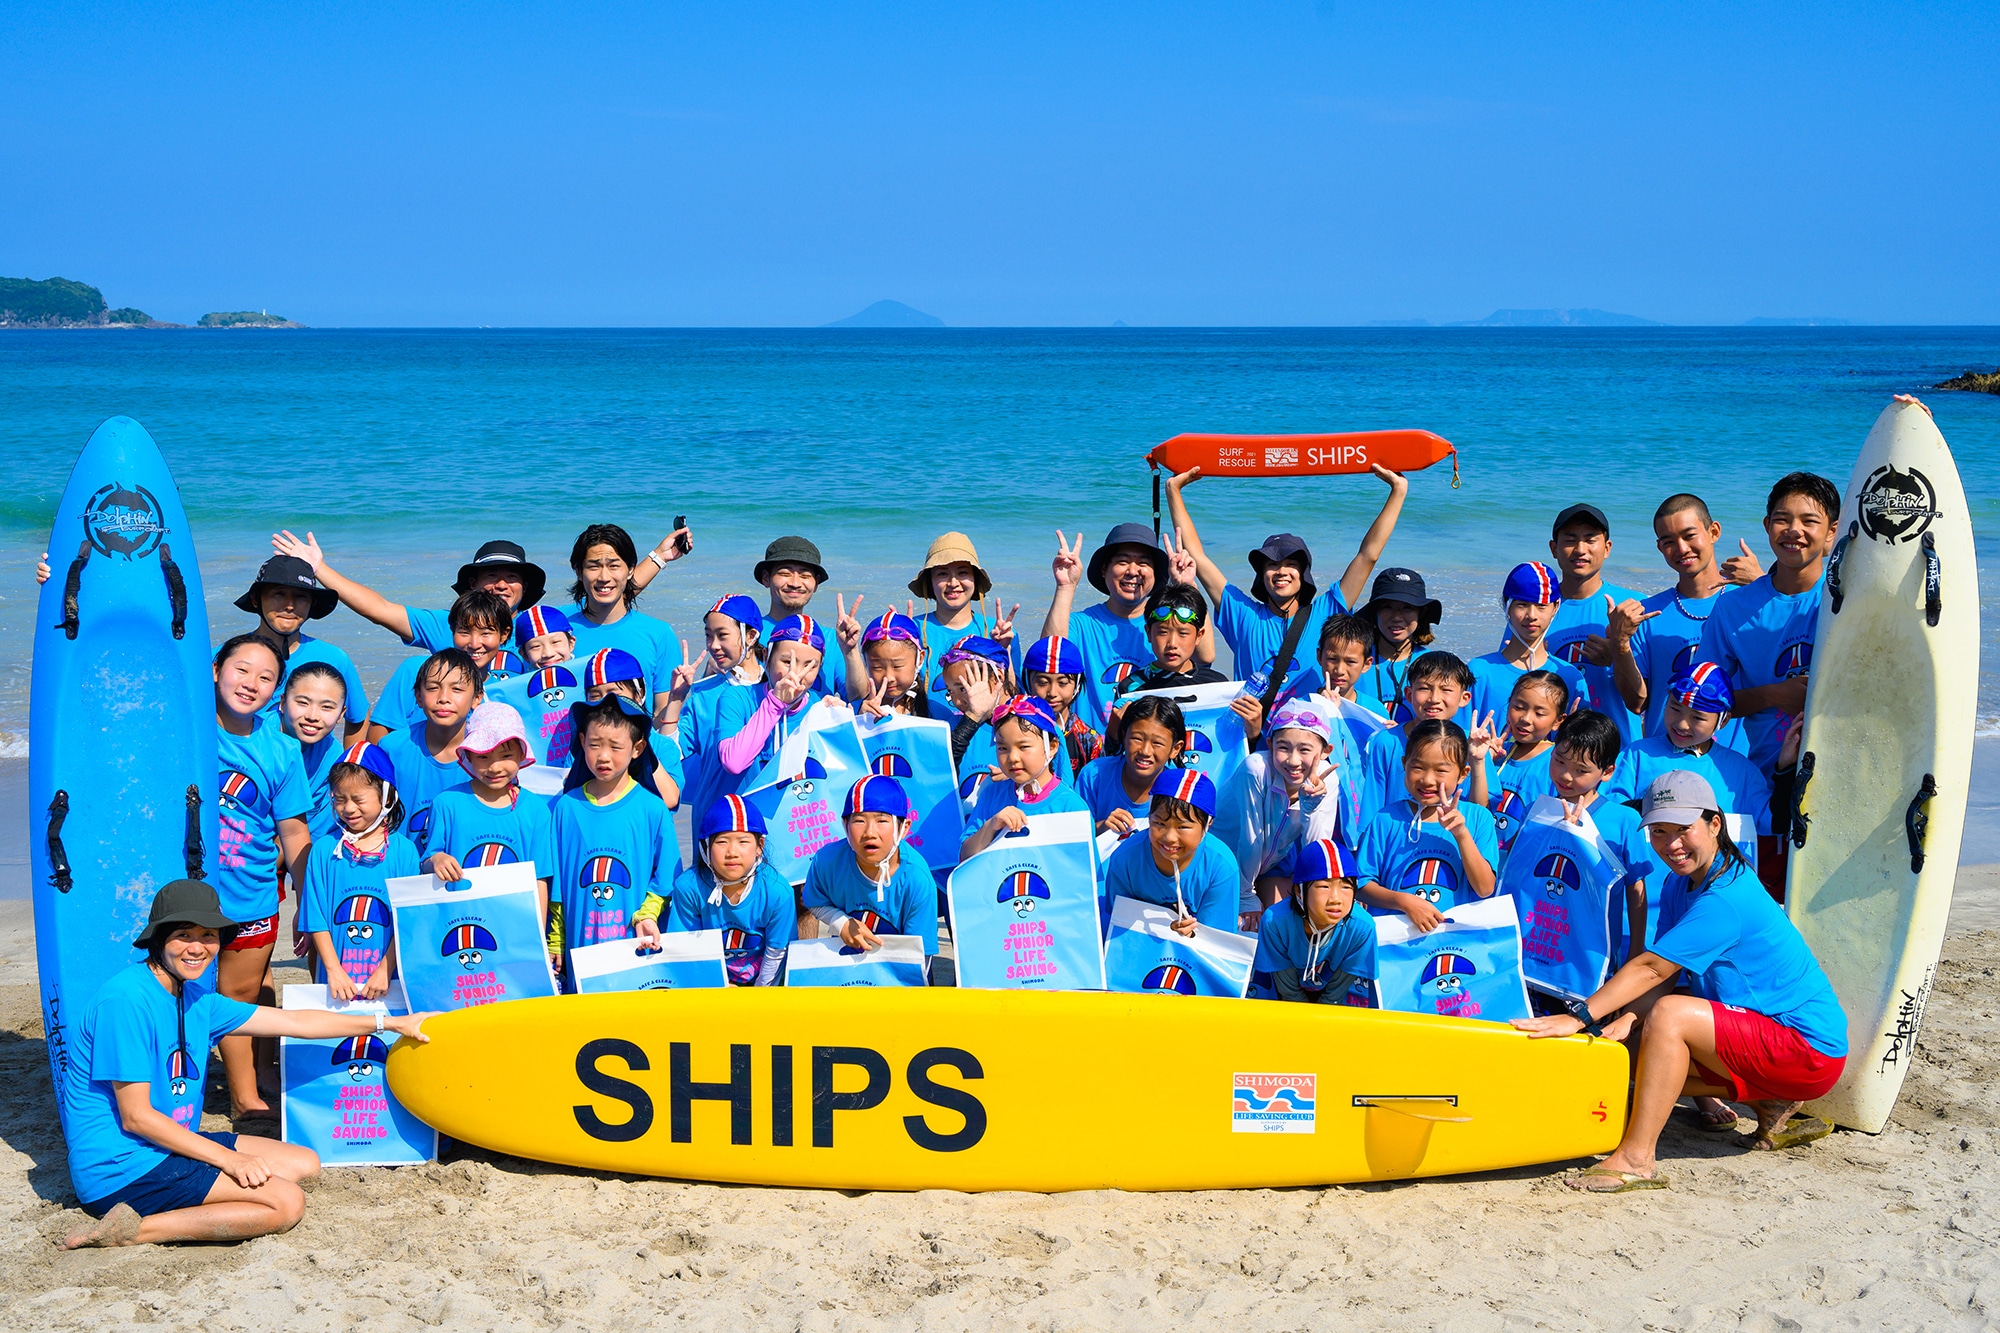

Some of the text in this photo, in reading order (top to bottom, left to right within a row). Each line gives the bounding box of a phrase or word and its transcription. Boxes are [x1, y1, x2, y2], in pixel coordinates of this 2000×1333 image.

[1218, 447, 1244, 457] SURF
[1307, 445, 1367, 466] SHIPS
[1218, 458, 1256, 467] RESCUE
[542, 708, 569, 724] SHIP
[540, 721, 571, 738] JUNI
[551, 733, 572, 747] LIF
[547, 746, 570, 761] SAV
[791, 799, 828, 818] SHIPS
[787, 811, 836, 833] JUNIOR
[219, 827, 252, 845] NIOR
[496, 834, 513, 843] CLEAN
[798, 826, 832, 843] LIFE
[604, 847, 622, 855] CLEAN
[1005, 864, 1017, 872] SAFE
[588, 909, 623, 925] SHIPS
[1533, 899, 1568, 921] SHIPS
[448, 918, 460, 926] SAFE
[1008, 920, 1047, 936] SHIPS
[1525, 911, 1570, 936] JUNIOR
[584, 925, 627, 939] JUNIOR
[1529, 926, 1561, 947] LIFE
[1003, 934, 1054, 951] JUNIOR
[1014, 949, 1046, 964] LIFE
[1428, 948, 1440, 956] SAFE
[341, 961, 381, 975] UNIO
[1006, 962, 1057, 979] SAVING
[1178, 958, 1193, 970] CLEAN
[456, 971, 496, 987] SHIPS
[638, 982, 650, 990] SAFE
[452, 983, 506, 1001] JUNIOR
[1235, 1076, 1313, 1087] SHIMODA
[340, 1084, 382, 1098] SHIPS
[572, 1037, 988, 1153] SHIPS
[333, 1098, 388, 1111] JUNIOR
[342, 1112, 378, 1125] LIFE
[331, 1126, 388, 1139] SAVING
